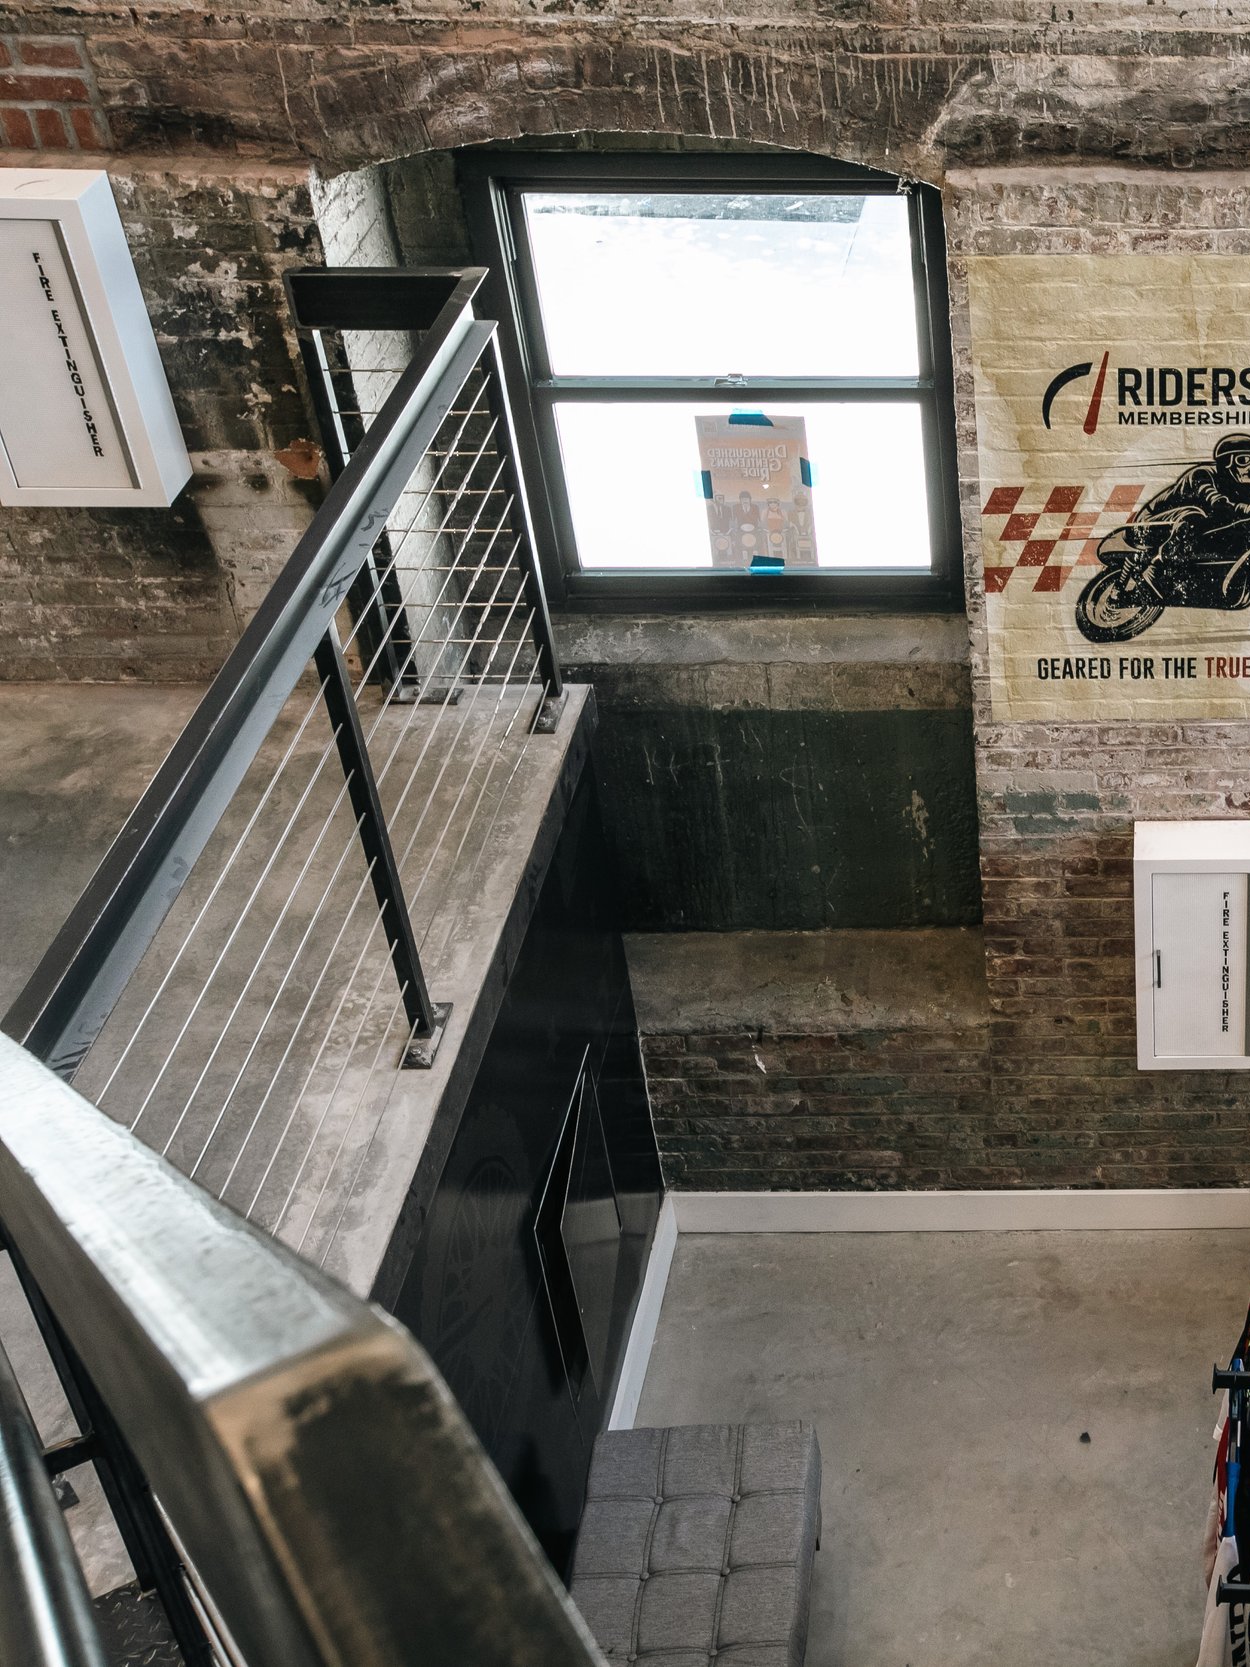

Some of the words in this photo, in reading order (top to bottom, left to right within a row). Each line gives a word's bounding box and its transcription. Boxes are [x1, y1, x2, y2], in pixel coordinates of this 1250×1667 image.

[32, 252, 54, 302] FIRE
[51, 309, 105, 457] EXTINGUISHER
[1037, 657, 1112, 680] GEARED
[1119, 657, 1154, 679] FOR
[1163, 656, 1197, 679] THE
